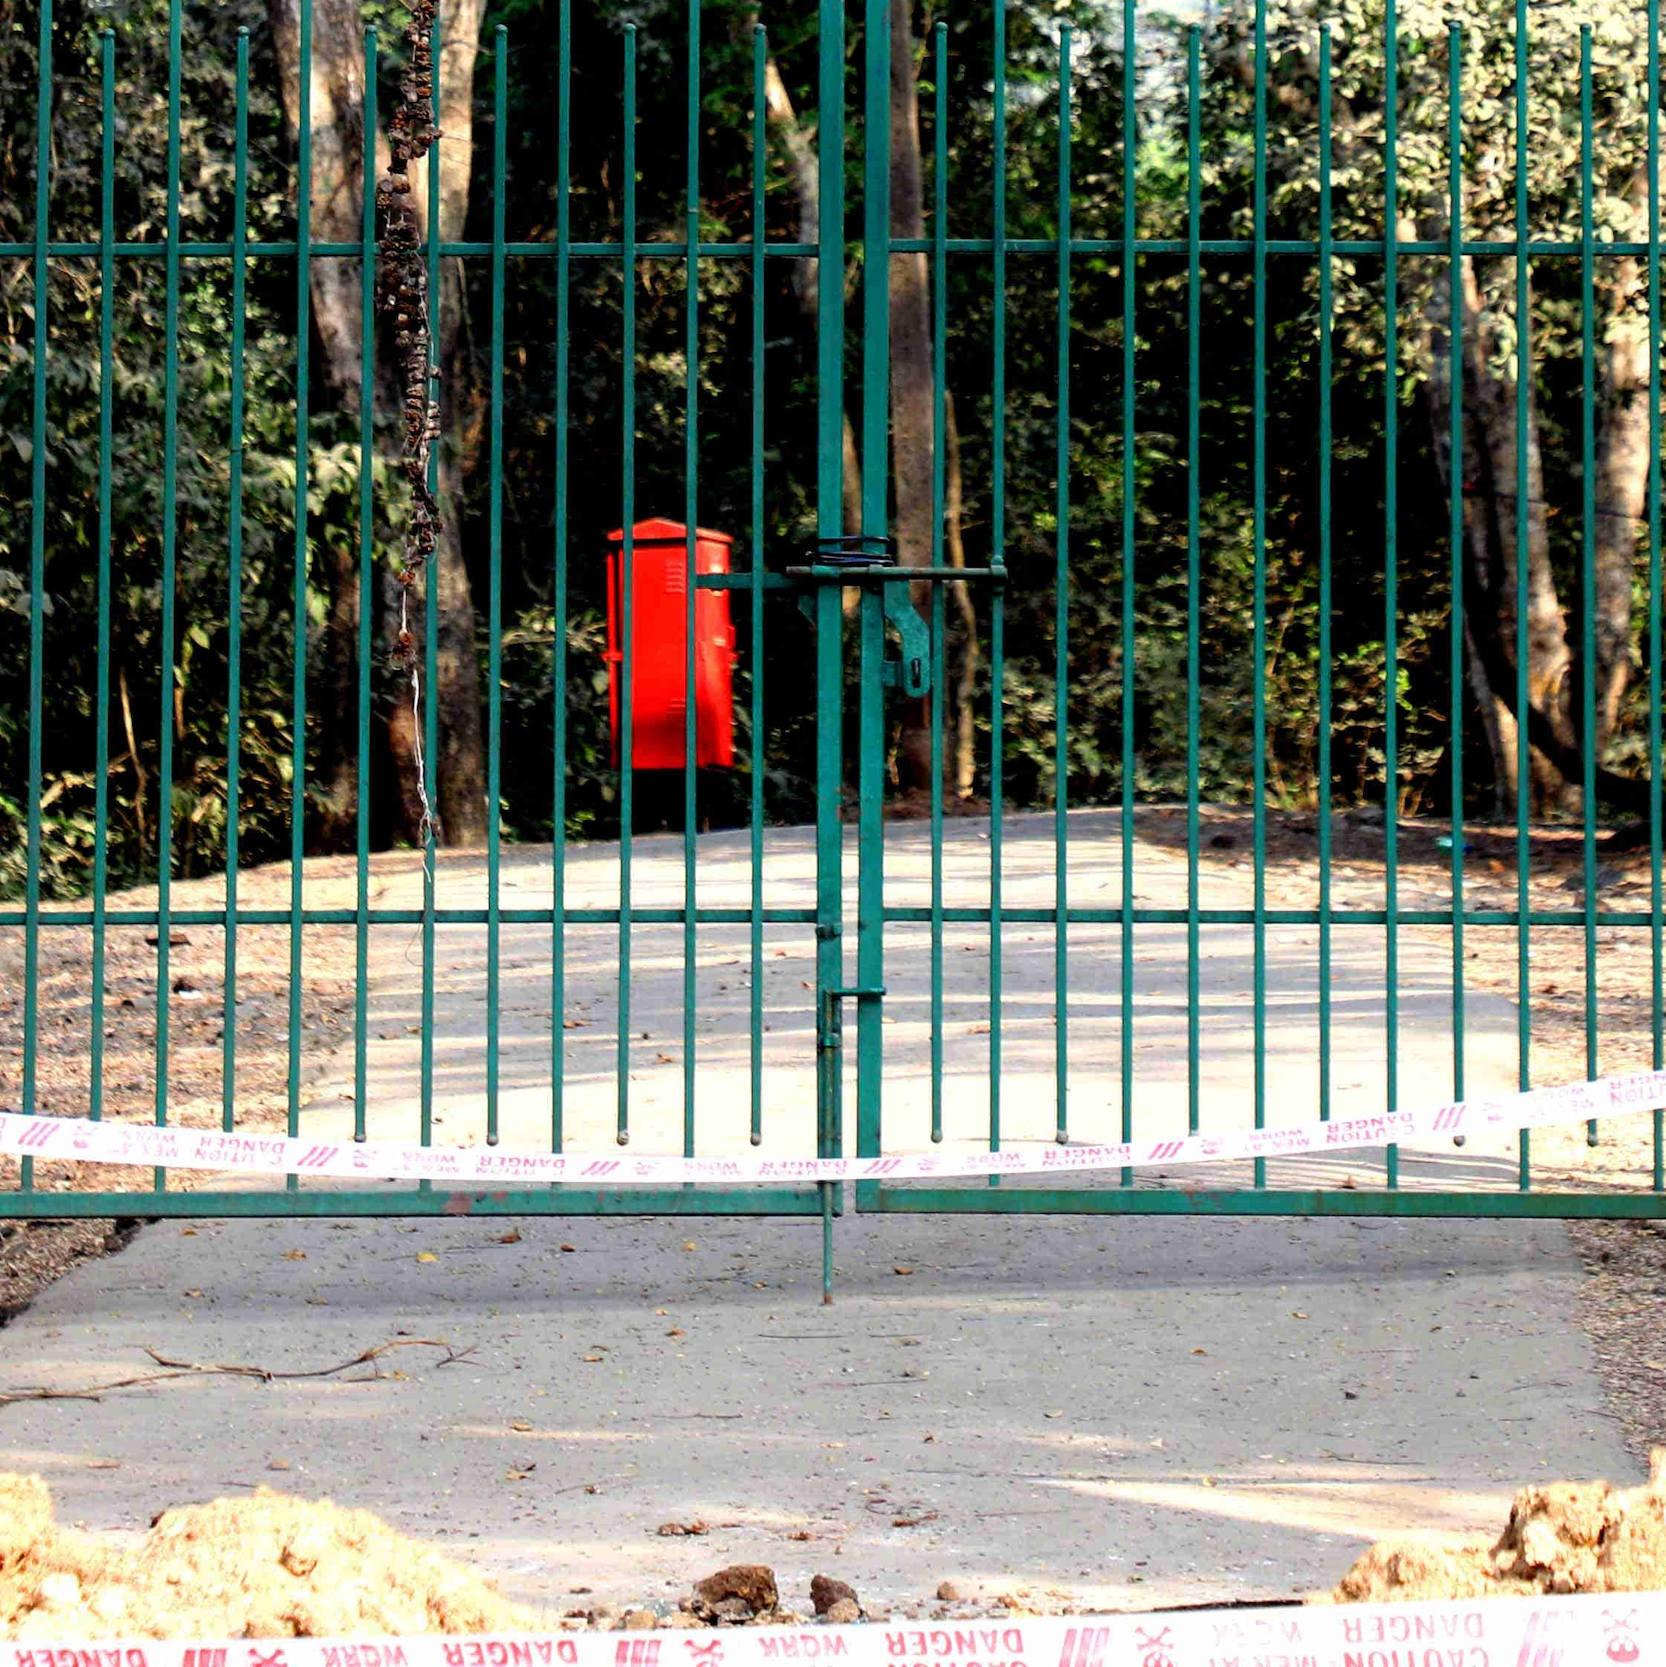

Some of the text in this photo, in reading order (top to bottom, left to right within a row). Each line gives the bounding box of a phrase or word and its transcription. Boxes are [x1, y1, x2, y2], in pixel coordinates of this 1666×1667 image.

[1343, 1613, 1484, 1644] DANGER
[14, 1647, 149, 1667] DANGER
[442, 1639, 578, 1666] DANGER
[757, 1628, 1024, 1658] DANGER WORK
